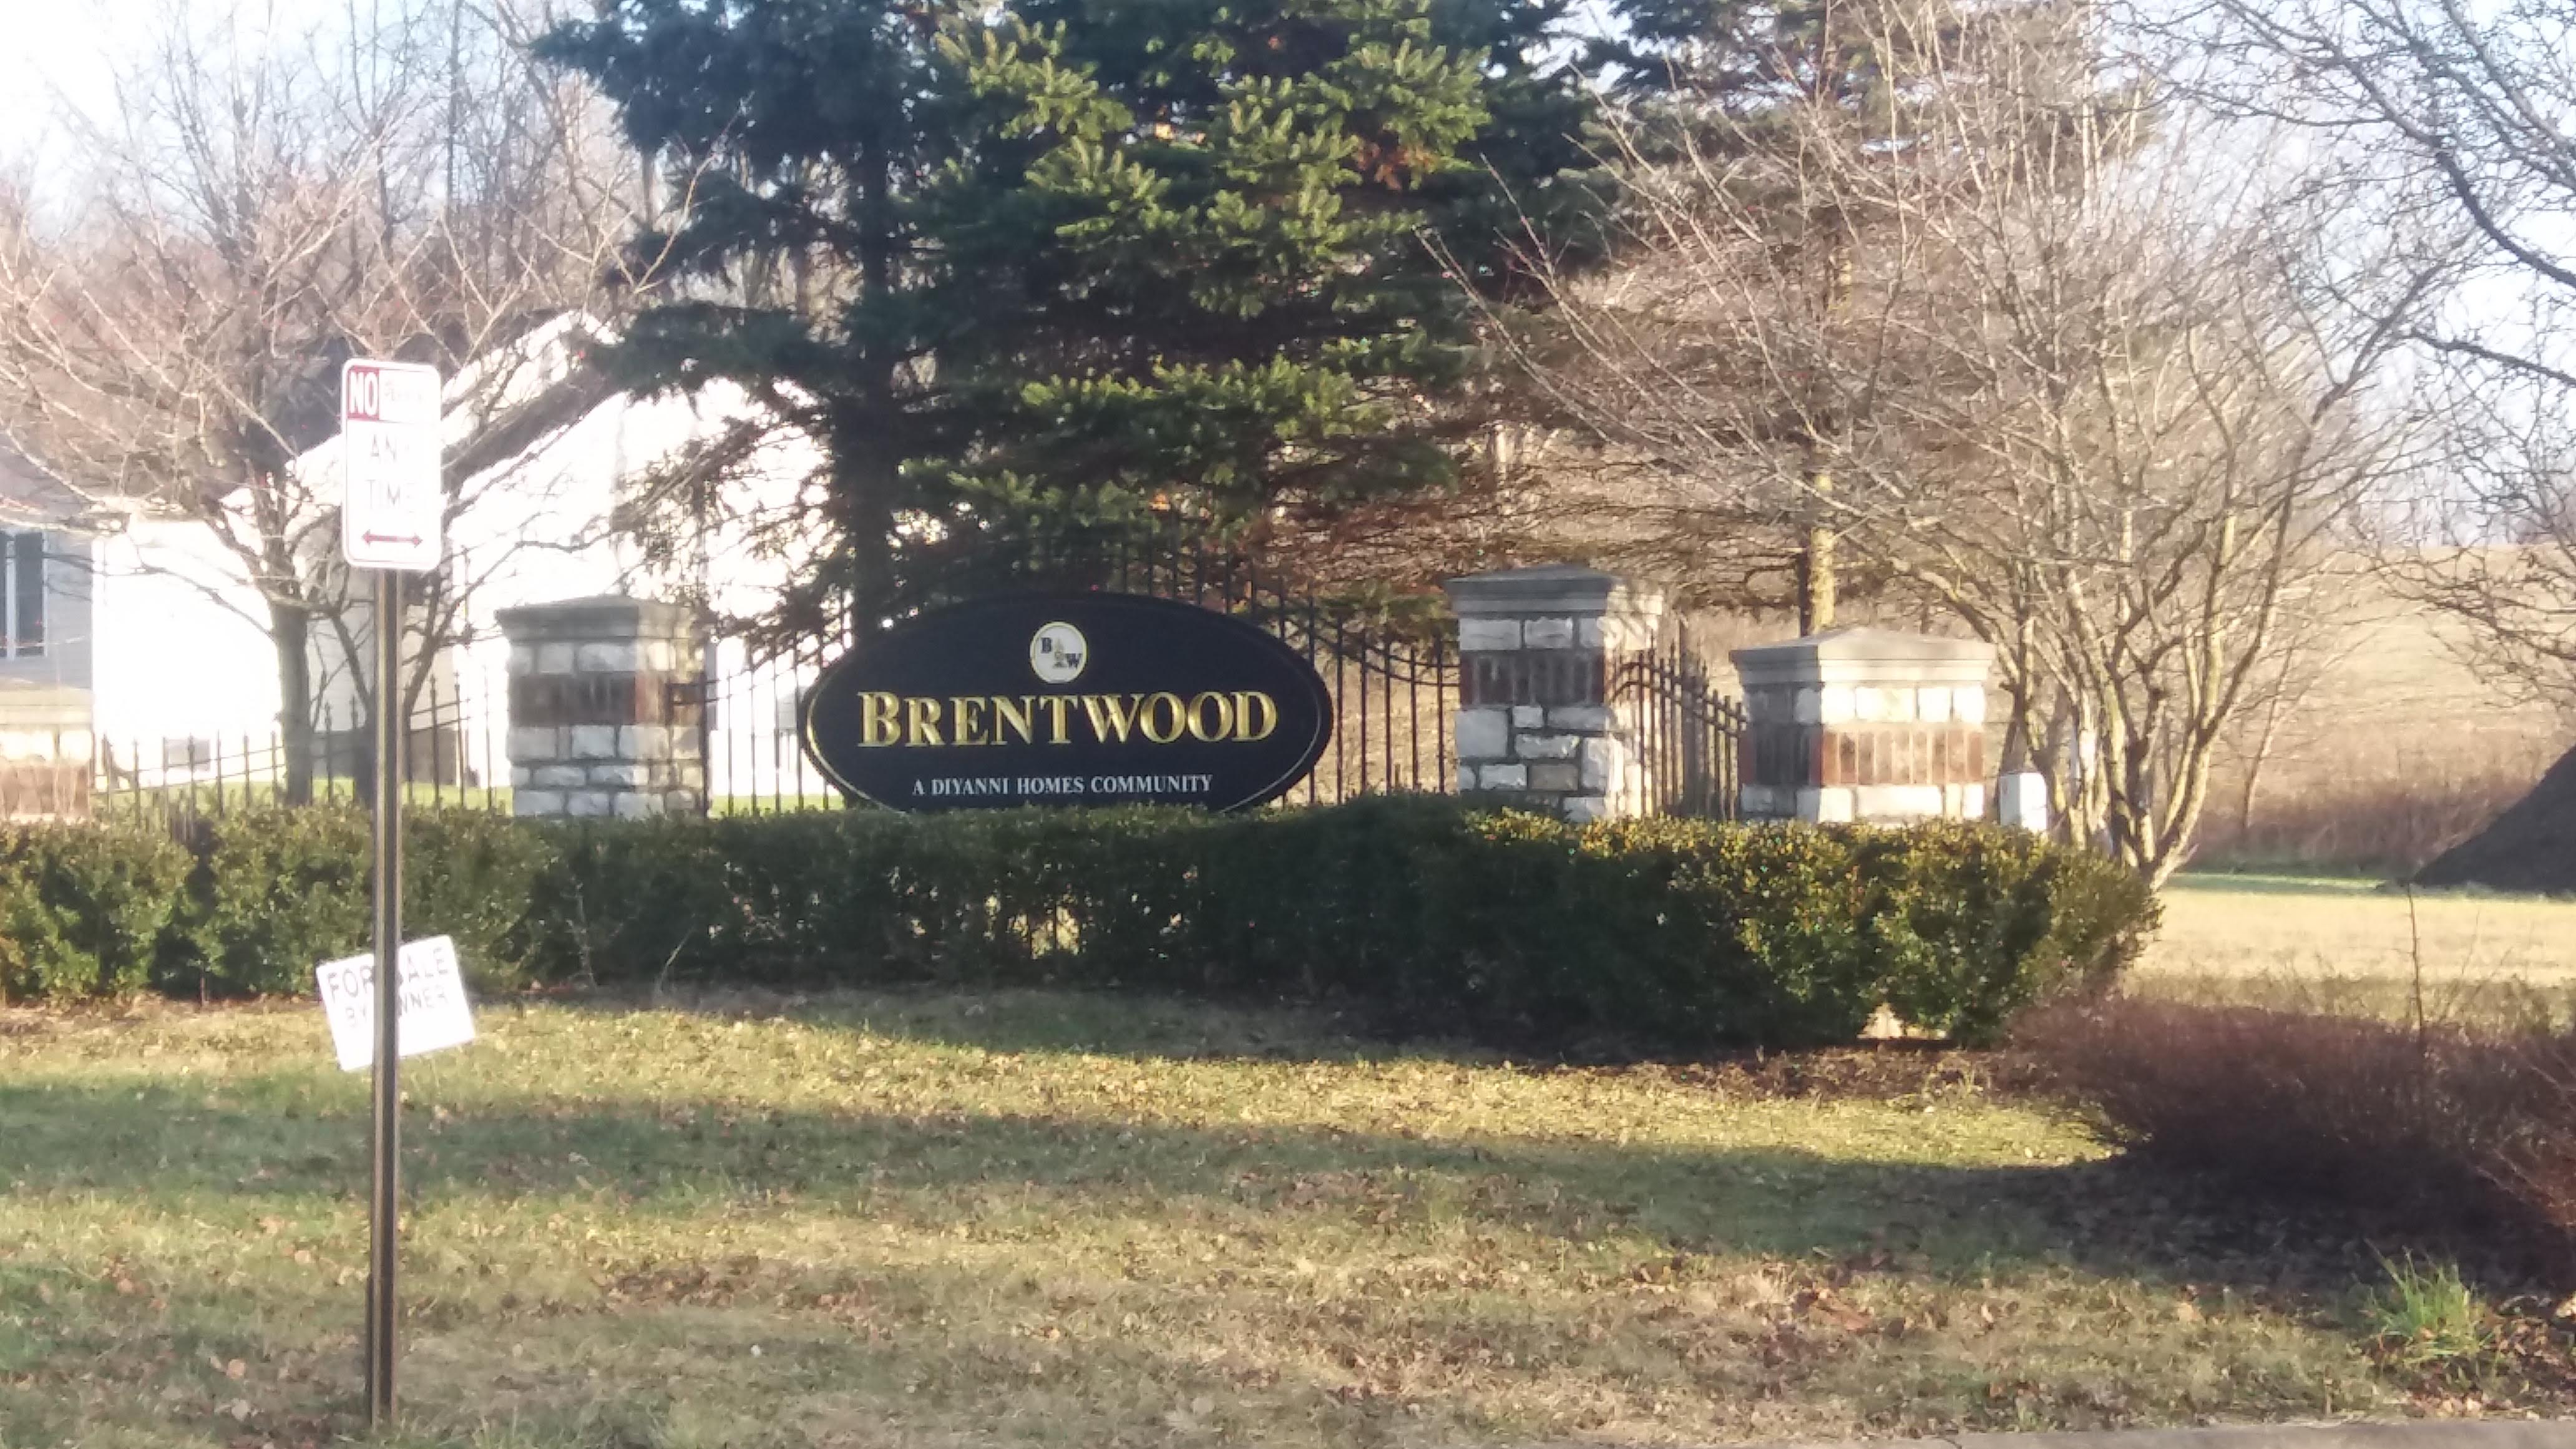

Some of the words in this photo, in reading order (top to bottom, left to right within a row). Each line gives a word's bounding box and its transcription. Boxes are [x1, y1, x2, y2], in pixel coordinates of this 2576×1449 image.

[351, 371, 378, 416] NO
[857, 691, 1278, 747] BRENTWOOD
[913, 779, 925, 795] A
[931, 778, 1009, 795] DIYANNI
[1017, 776, 1084, 794] HOMES
[1091, 774, 1212, 794] COMMUNITY
[327, 965, 373, 1003] FOR
[399, 946, 449, 984] ALE
